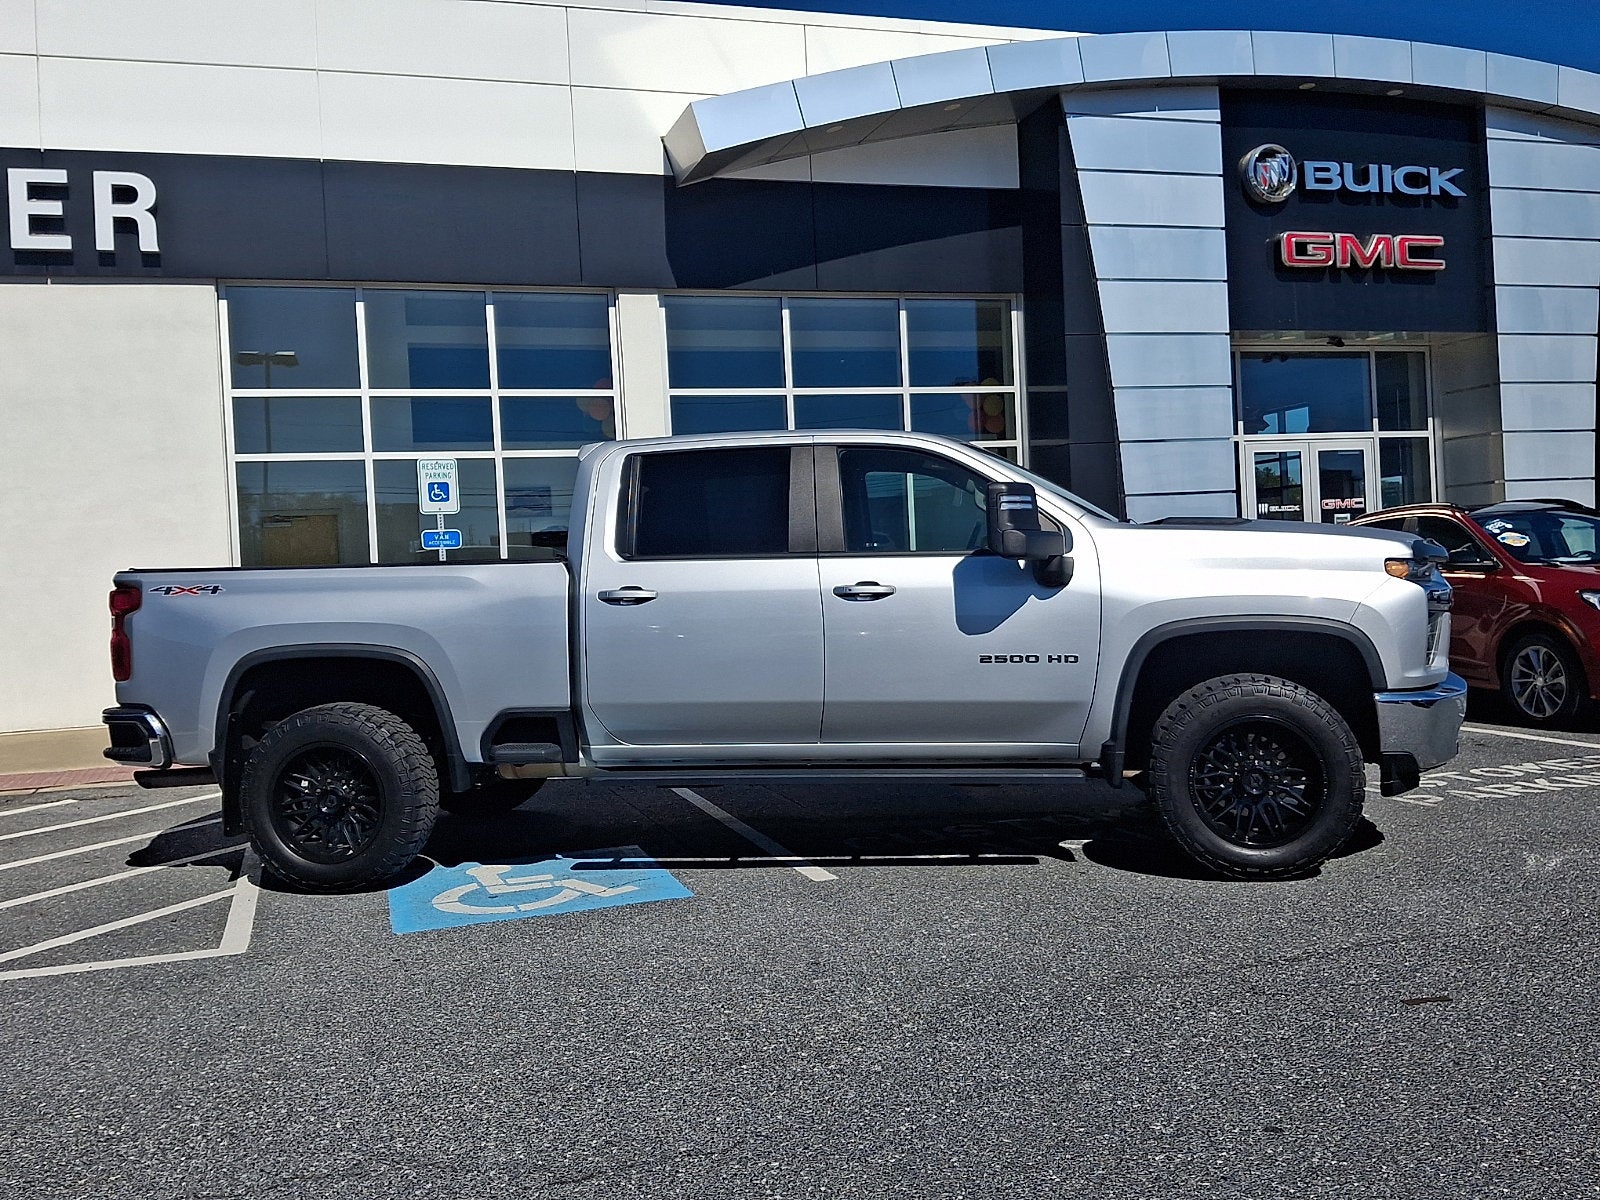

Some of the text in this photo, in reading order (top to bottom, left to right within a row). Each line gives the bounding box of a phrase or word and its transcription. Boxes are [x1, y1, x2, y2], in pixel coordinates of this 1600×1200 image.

[1303, 160, 1467, 197] BUICK
[7, 168, 160, 252] ER
[1280, 231, 1446, 271] GMC
[421, 463, 454, 471] RESERVED
[1321, 498, 1365, 510] GMC
[979, 654, 1079, 664] 2500 HD
